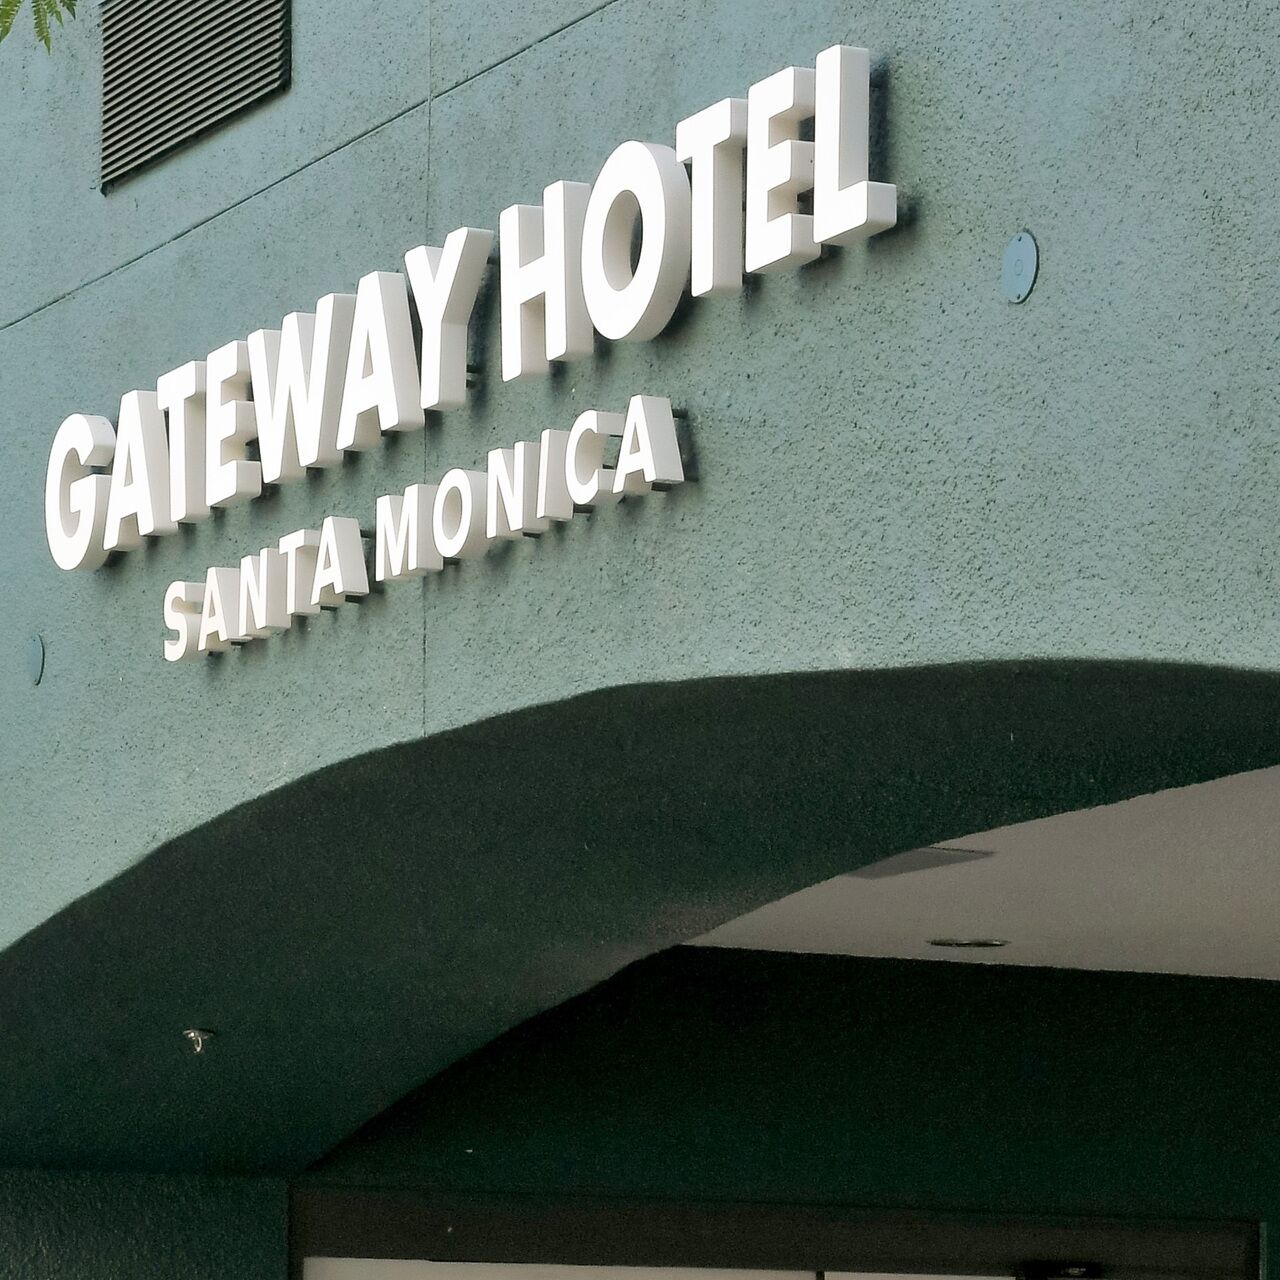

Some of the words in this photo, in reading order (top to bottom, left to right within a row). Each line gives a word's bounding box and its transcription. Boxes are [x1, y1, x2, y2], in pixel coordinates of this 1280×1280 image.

[45, 228, 494, 571] GATEWAY
[499, 44, 897, 382] HOTEL
[163, 516, 370, 663] SANTA
[375, 395, 685, 582] MONICA
